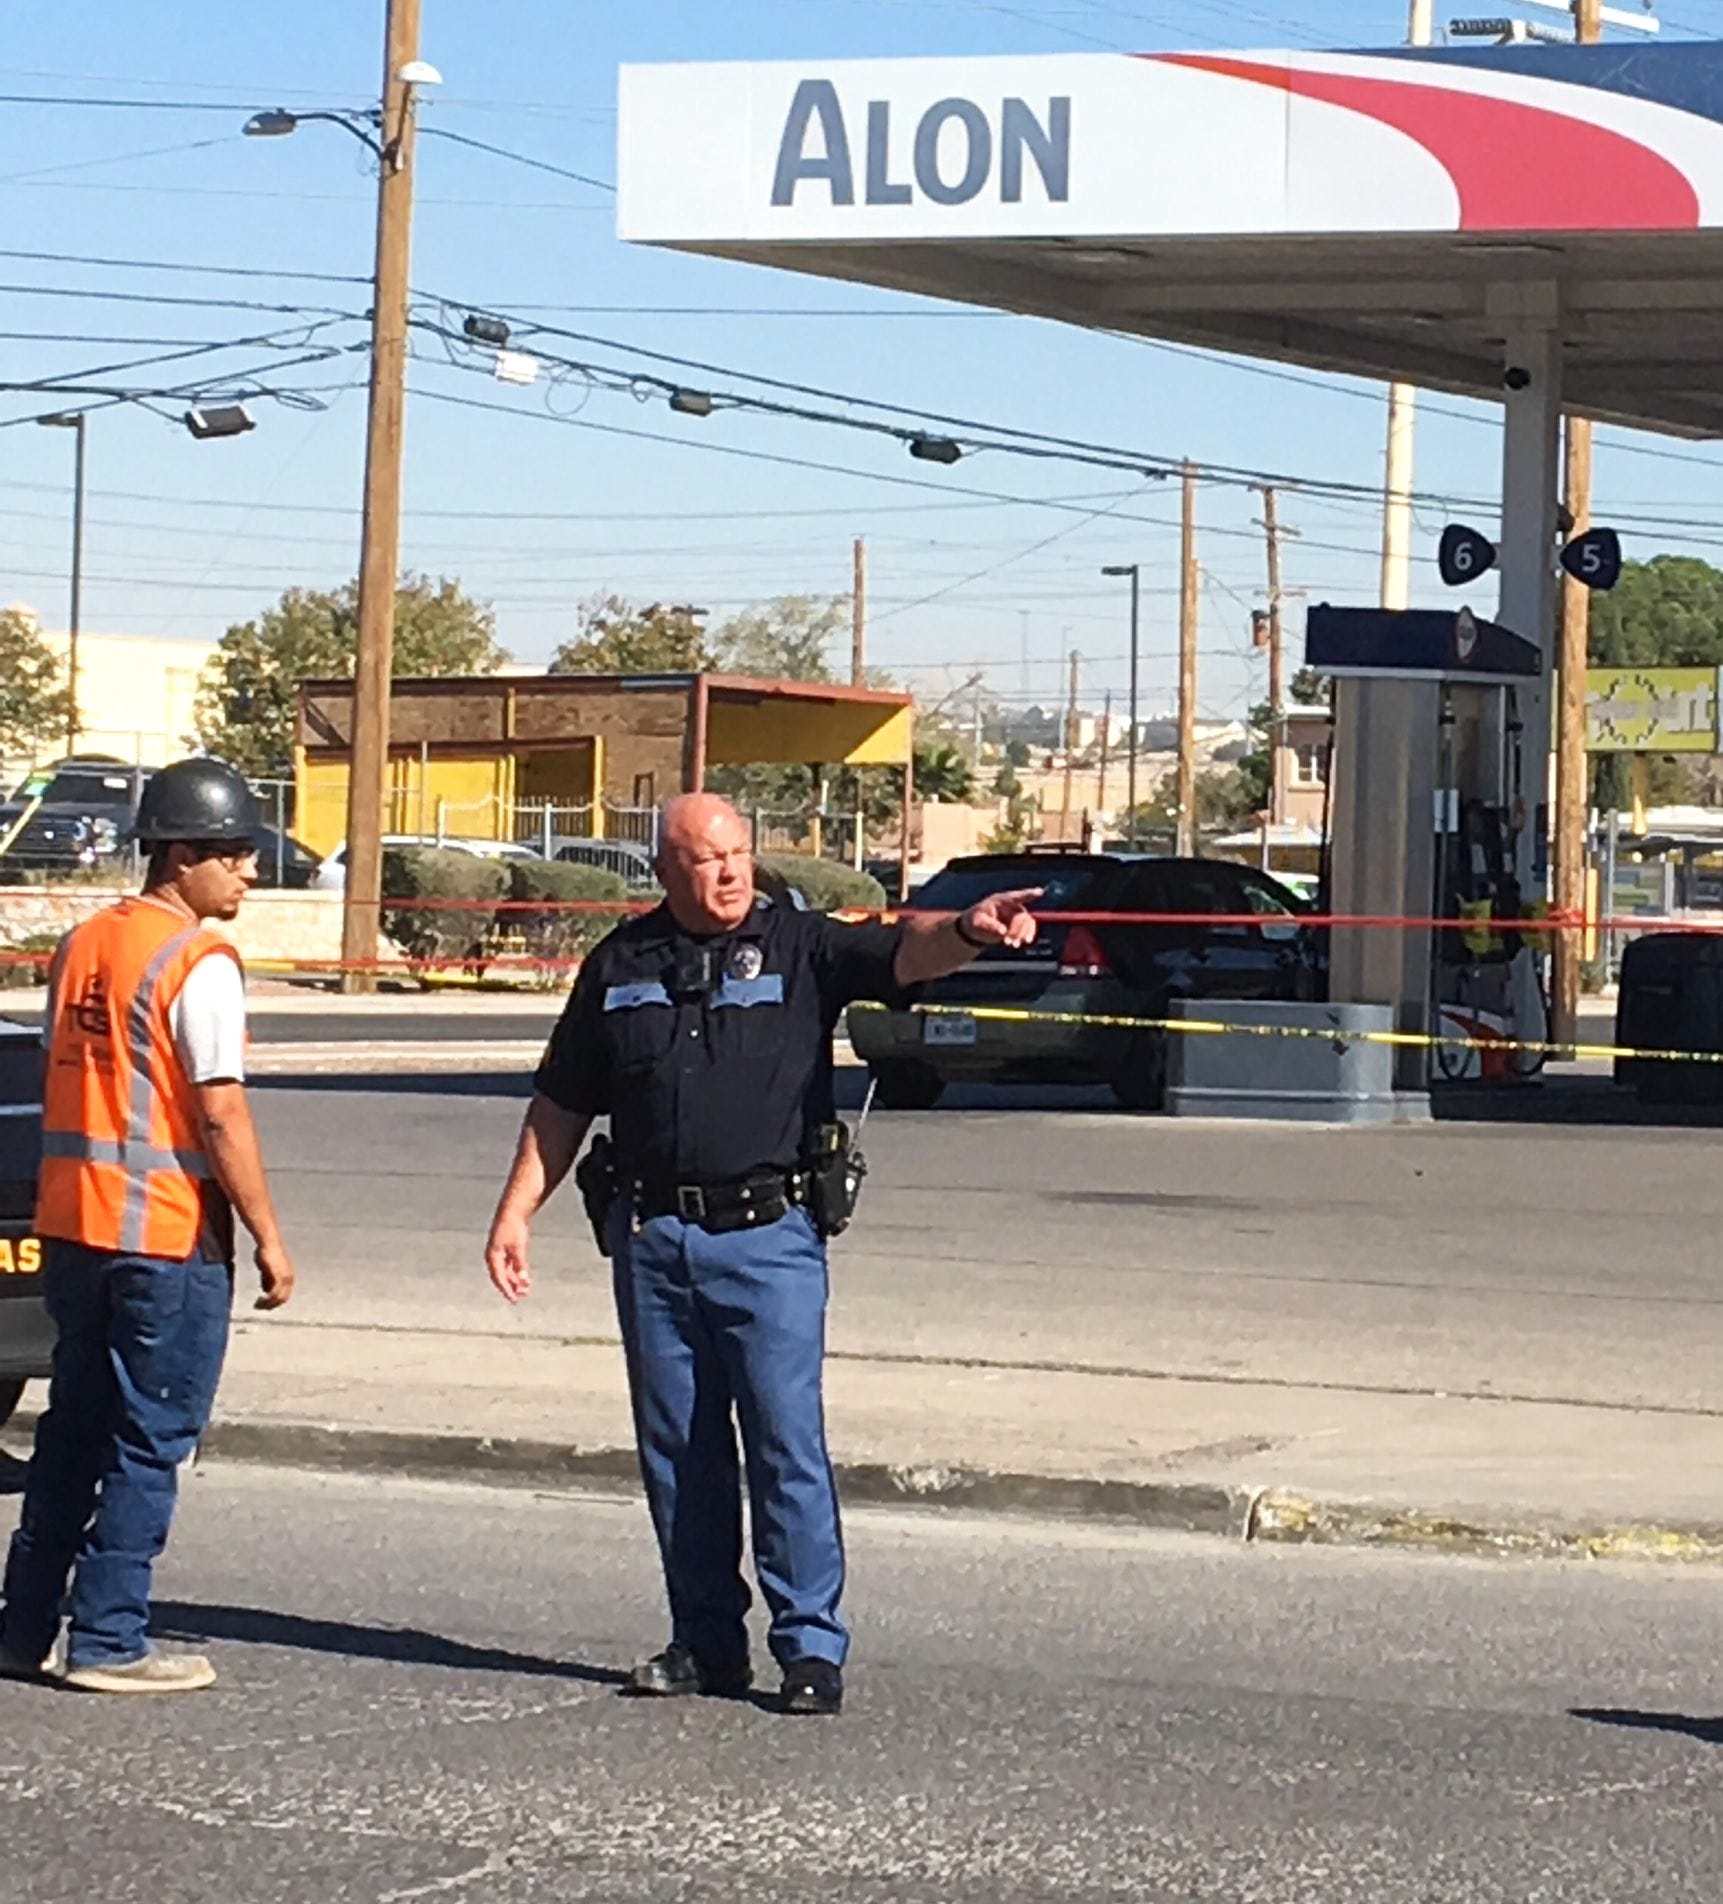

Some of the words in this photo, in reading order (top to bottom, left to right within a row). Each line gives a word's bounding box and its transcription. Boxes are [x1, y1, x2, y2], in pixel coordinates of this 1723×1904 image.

[770, 79, 1071, 206] ALON
[1454, 541, 1473, 571] 6
[1581, 543, 1602, 573] 5
